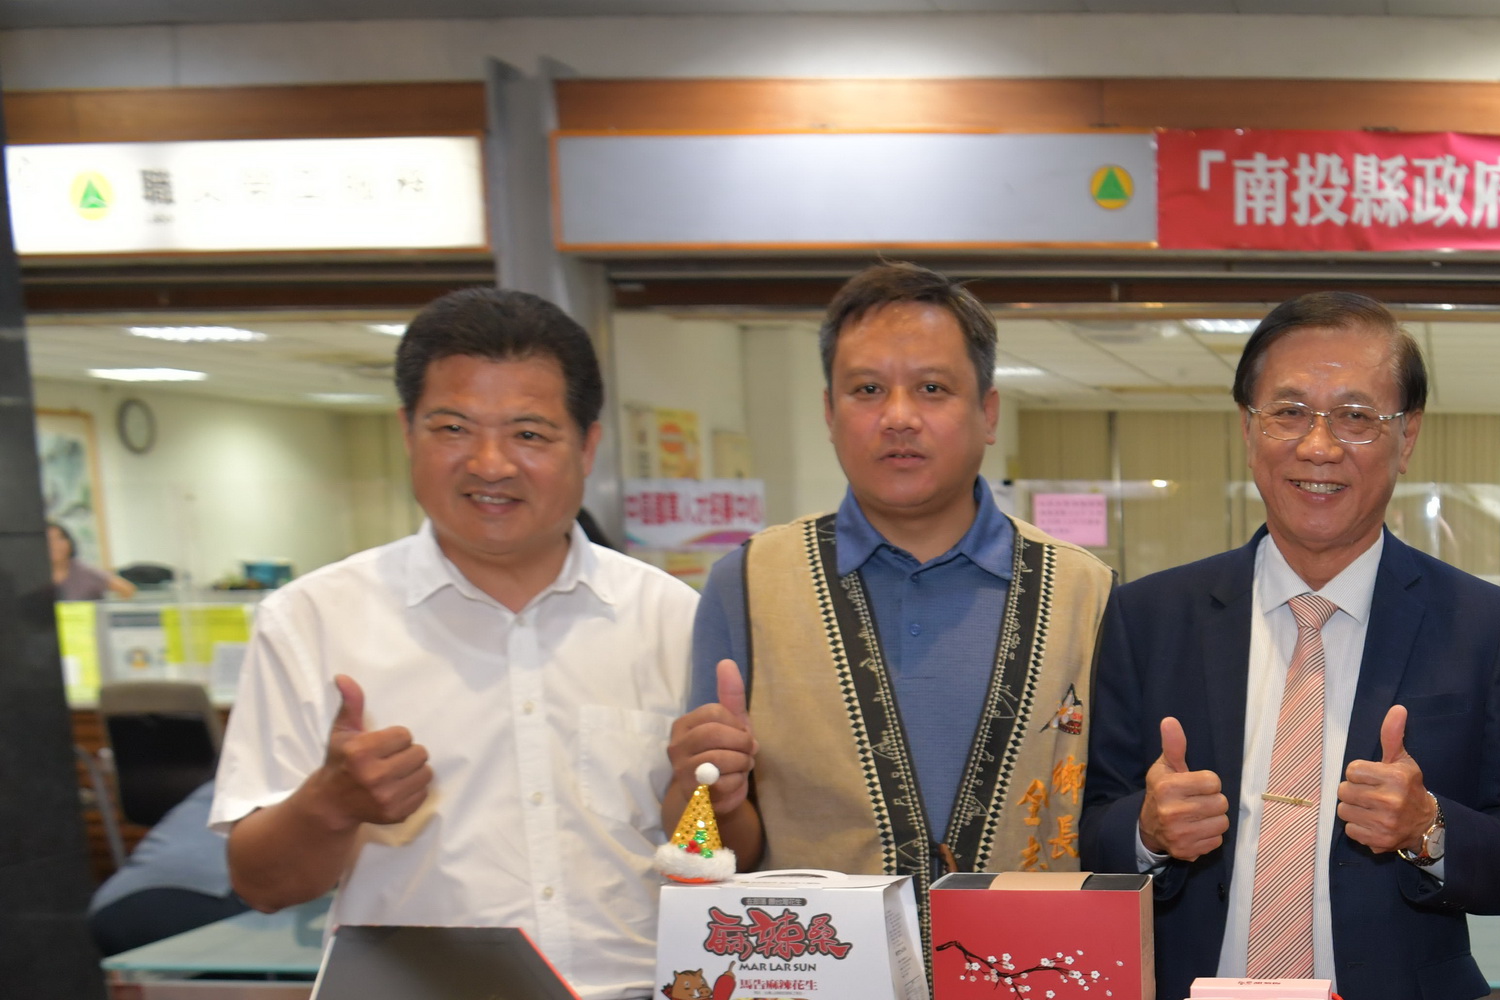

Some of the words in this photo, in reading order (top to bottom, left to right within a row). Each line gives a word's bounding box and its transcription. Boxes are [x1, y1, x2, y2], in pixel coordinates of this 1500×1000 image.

[1048, 754, 1086, 861] 鄉長
[739, 962, 767, 972] MAR
[769, 962, 791, 972] LAR
[793, 962, 817, 972] SUN
